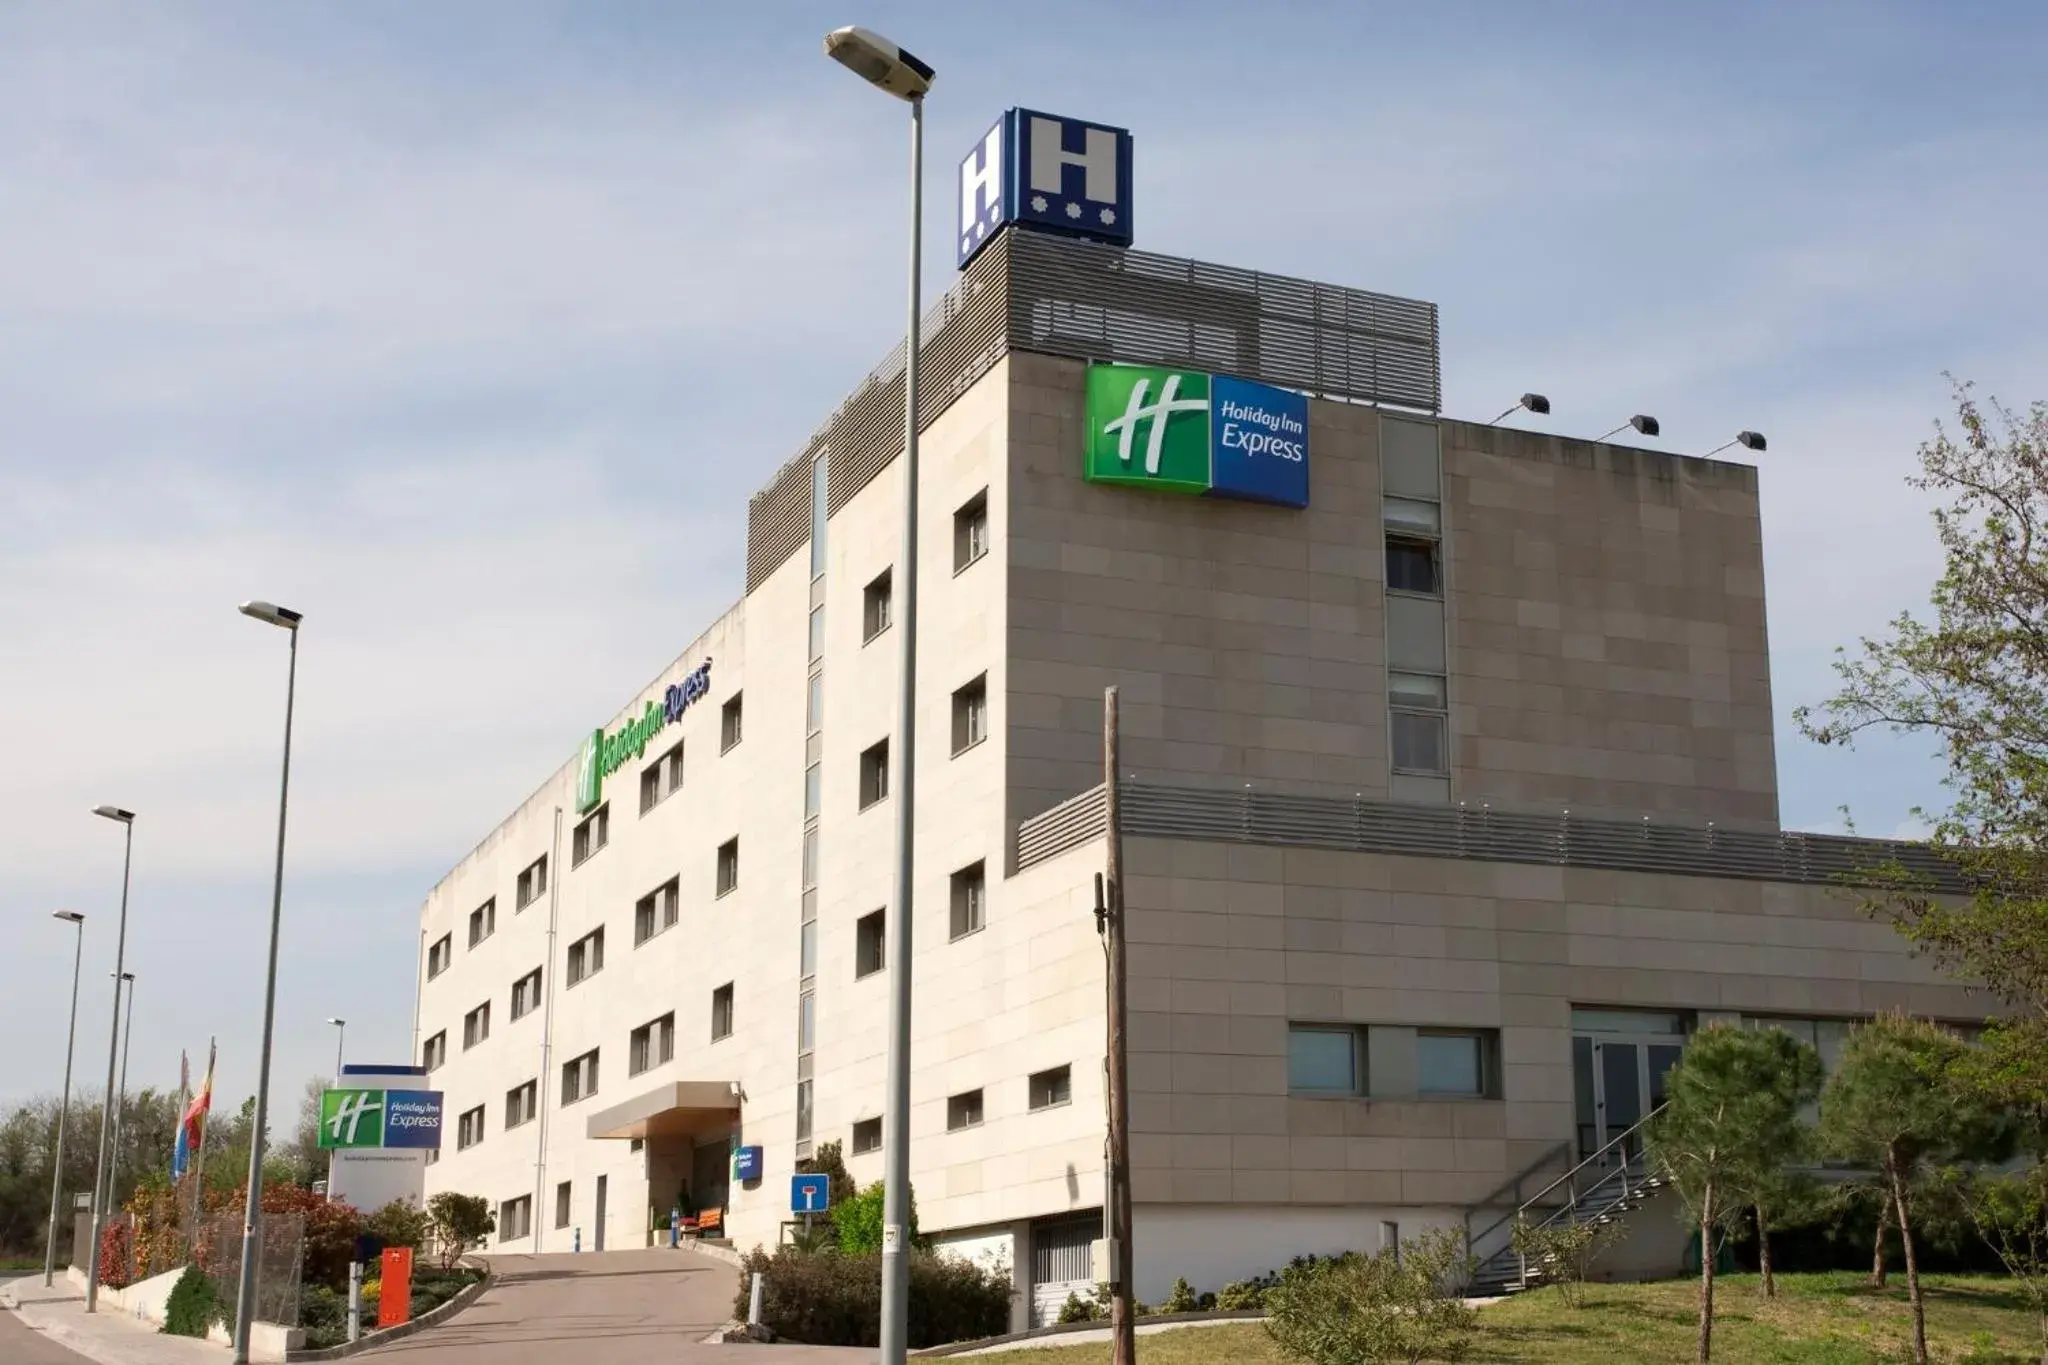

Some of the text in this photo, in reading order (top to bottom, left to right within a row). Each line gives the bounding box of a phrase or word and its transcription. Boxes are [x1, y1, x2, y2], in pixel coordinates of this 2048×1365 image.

[962, 123, 1000, 236] H
[1030, 116, 1117, 204] H
[1104, 375, 1209, 474] H
[1221, 401, 1302, 433] Holiday Inn
[1221, 423, 1303, 462] Express
[325, 1092, 381, 1144] H
[390, 1113, 440, 1128] Express
[391, 1102, 440, 1115] Holiday Inn
